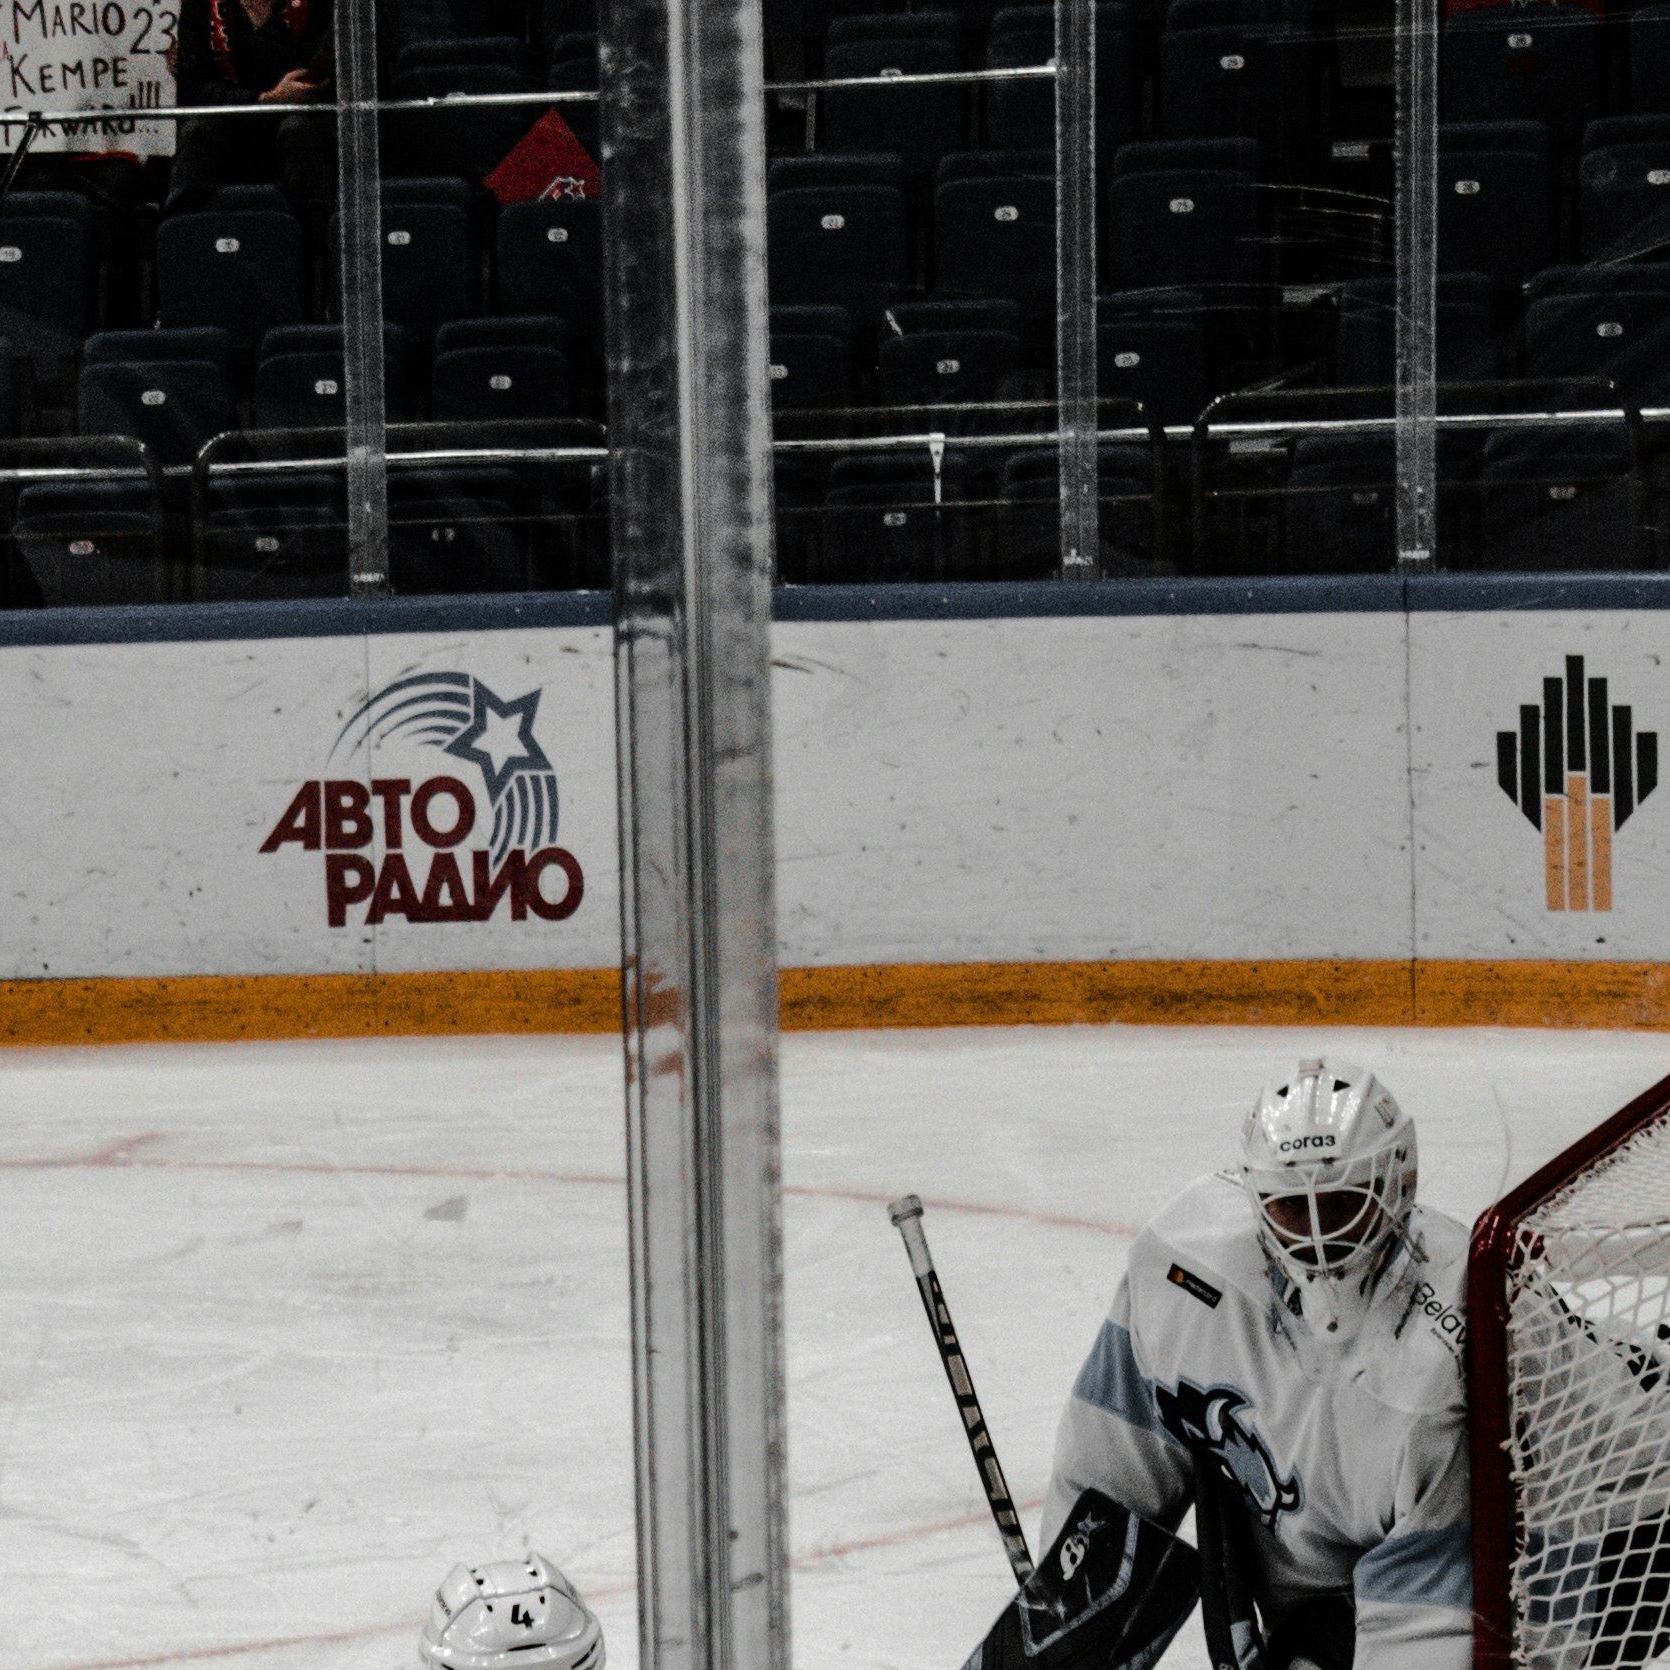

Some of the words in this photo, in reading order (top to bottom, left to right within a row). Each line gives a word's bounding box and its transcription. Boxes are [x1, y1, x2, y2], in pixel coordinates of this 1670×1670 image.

[12, 0, 125, 44] MARIO
[130, 8, 178, 54] 23
[9, 54, 129, 97] KEMPE
[258, 775, 476, 854] АВТО
[325, 847, 585, 928] РАДИО
[1413, 1282, 1467, 1345] Belav
[510, 1603, 535, 1629] 4
